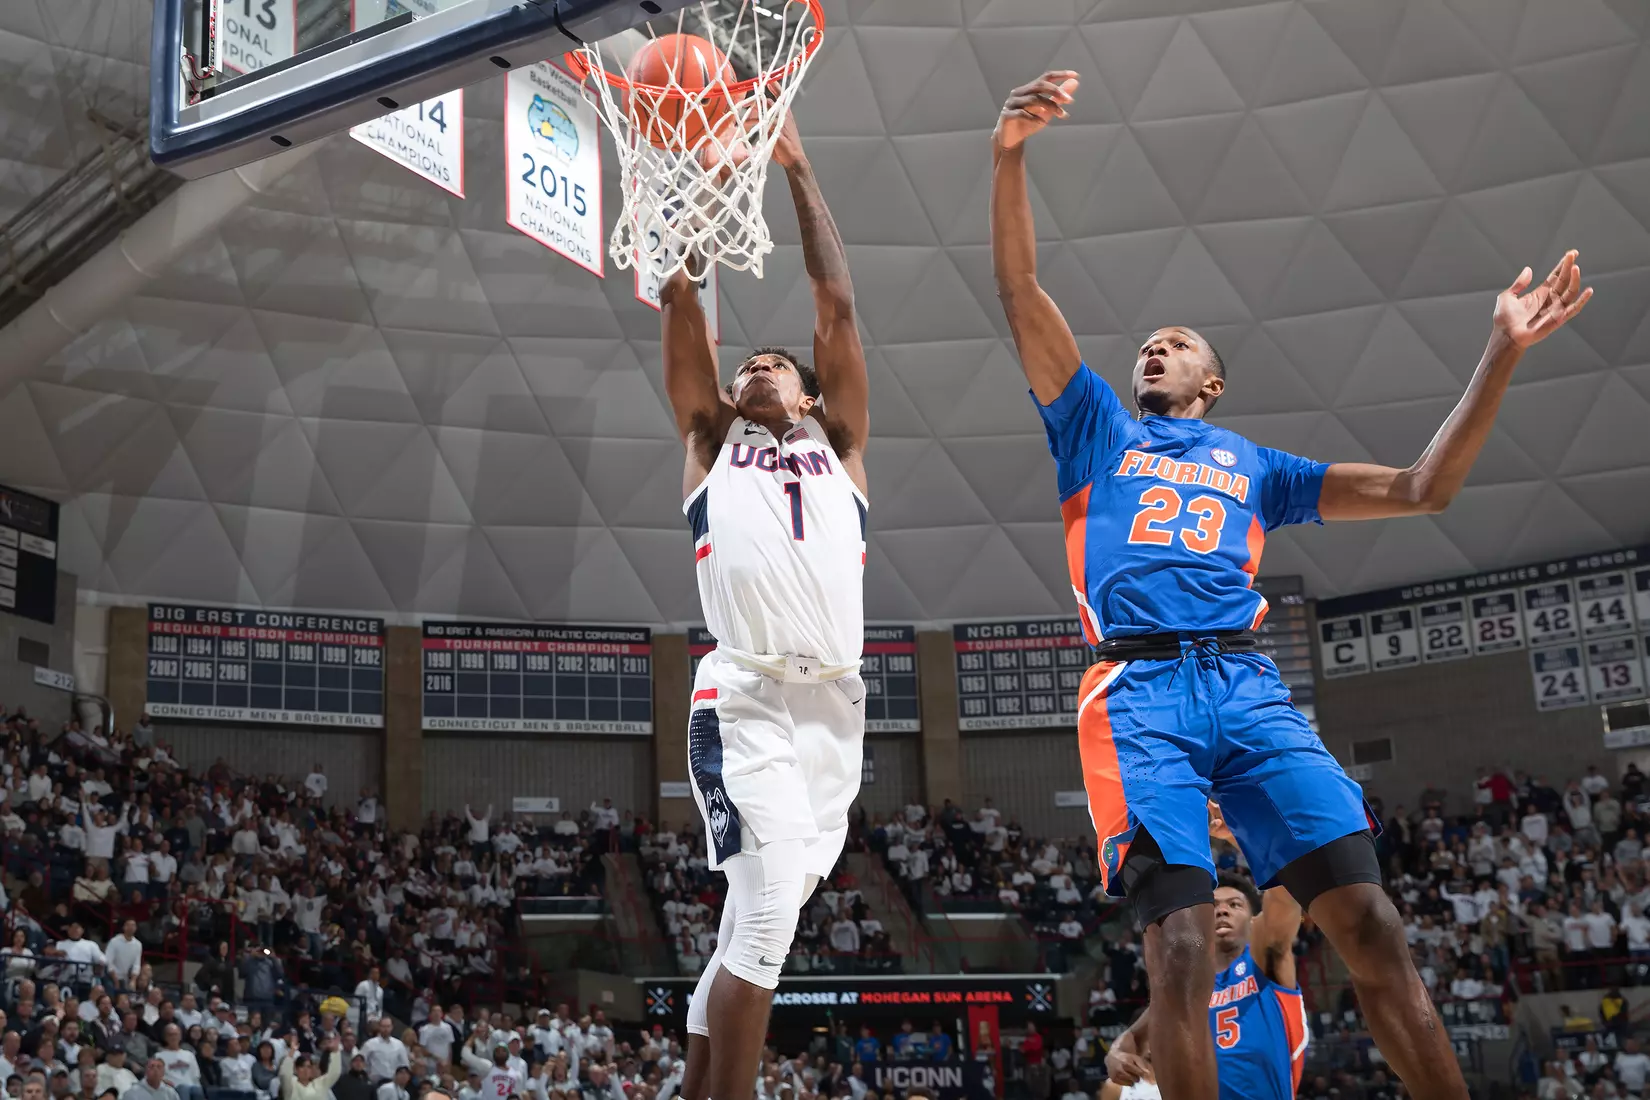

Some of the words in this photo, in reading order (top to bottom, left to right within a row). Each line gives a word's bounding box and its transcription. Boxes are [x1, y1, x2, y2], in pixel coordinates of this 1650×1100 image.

[226, 18, 273, 56] ONAL
[418, 100, 447, 134] 14
[379, 114, 444, 157] ATIONAL
[367, 125, 450, 182] CHAMPIONS
[522, 153, 586, 216] 2015
[525, 193, 587, 240] NATIONAL
[520, 212, 592, 262] CHAMPIONS
[1212, 449, 1236, 467] SEC
[1113, 449, 1250, 504] FLORIDA
[783, 481, 805, 541] 1
[1127, 485, 1227, 555] 23
[1401, 581, 1457, 599] UCONN
[1465, 567, 1539, 589] HUSKIES
[1546, 561, 1568, 576] OF
[152, 606, 186, 620] BIG
[195, 609, 246, 624] EAST
[255, 613, 378, 633] CONFERENCE
[1533, 608, 1571, 632] 42
[1587, 599, 1625, 624] 44
[152, 623, 221, 635] REGULAR
[228, 627, 287, 640] SEASON
[293, 630, 379, 645] CHAMPIONS
[446, 626, 472, 636] EAST
[585, 631, 646, 642] CONFERENCE
[967, 625, 1018, 638] NCAA
[1427, 625, 1464, 650] 22
[1479, 616, 1516, 642] 25
[187, 638, 213, 655] 1994
[221, 640, 246, 657] 1995
[354, 649, 381, 665] 2002
[444, 639, 541, 651] TOURNAMENT
[547, 641, 630, 654] CHAMPIONS
[967, 637, 1062, 650] TOURNAMENT
[1334, 643, 1356, 664] C
[1387, 635, 1401, 656] 9
[184, 662, 212, 679] 2005
[557, 655, 583, 672] 2002
[589, 656, 616, 672] 2004
[1541, 671, 1580, 697] 24
[1600, 664, 1631, 689] 13
[152, 705, 244, 719] CONNECTICUT
[295, 712, 377, 726] BASKETBALL
[429, 718, 516, 730] CONNECTICUT
[565, 722, 647, 733] BASKETBALL
[866, 721, 914, 731] ETBALL
[966, 716, 1053, 729] CONNECTICUT
[773, 992, 838, 1005] ACROSSE
[840, 991, 859, 1005] AT
[861, 991, 931, 1004] MOHEGAN
[933, 991, 962, 1004] SUN
[964, 991, 1014, 1003] ARENA
[1209, 975, 1259, 1009] ORIDA
[1215, 1006, 1241, 1050] 5
[874, 1066, 963, 1089] UCONN
